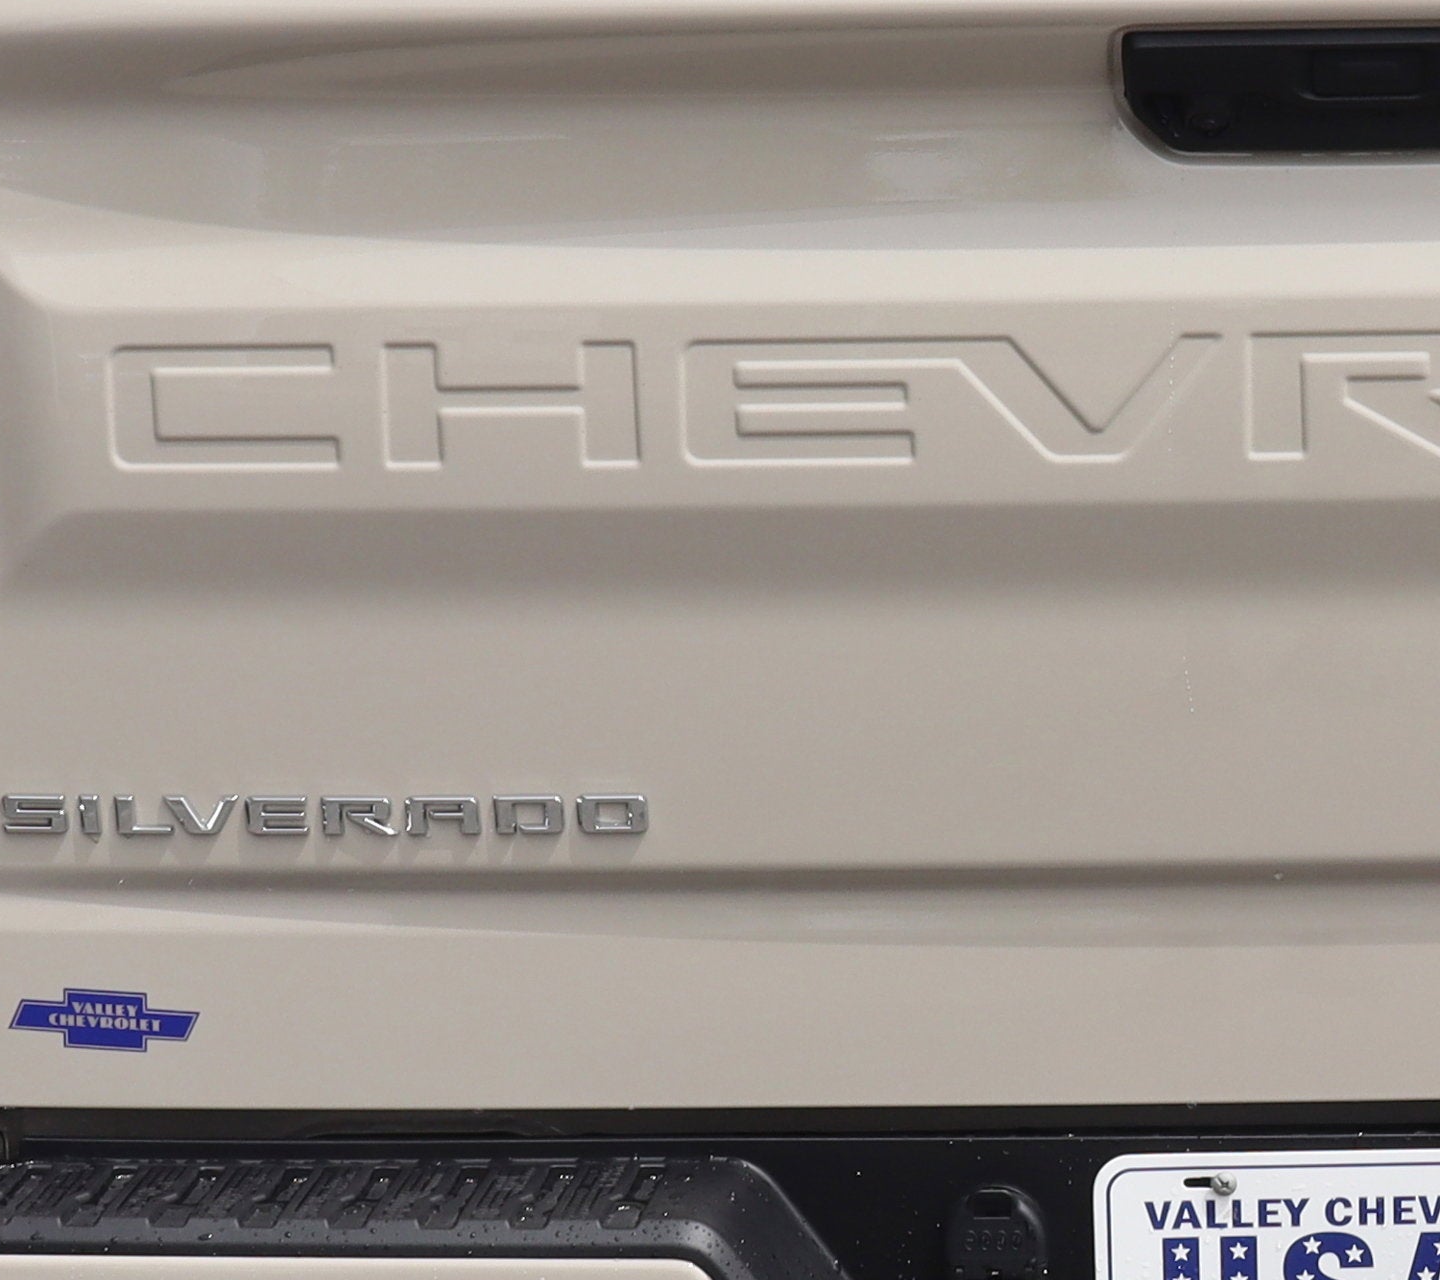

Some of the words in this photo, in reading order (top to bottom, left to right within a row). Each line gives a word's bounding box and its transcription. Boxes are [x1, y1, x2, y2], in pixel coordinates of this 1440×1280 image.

[0, 794, 649, 837] SILVERADO
[48, 1012, 163, 1033] CHEVROLET
[70, 1001, 139, 1018] VALLEY
[1144, 1197, 1311, 1231] VALLEY
